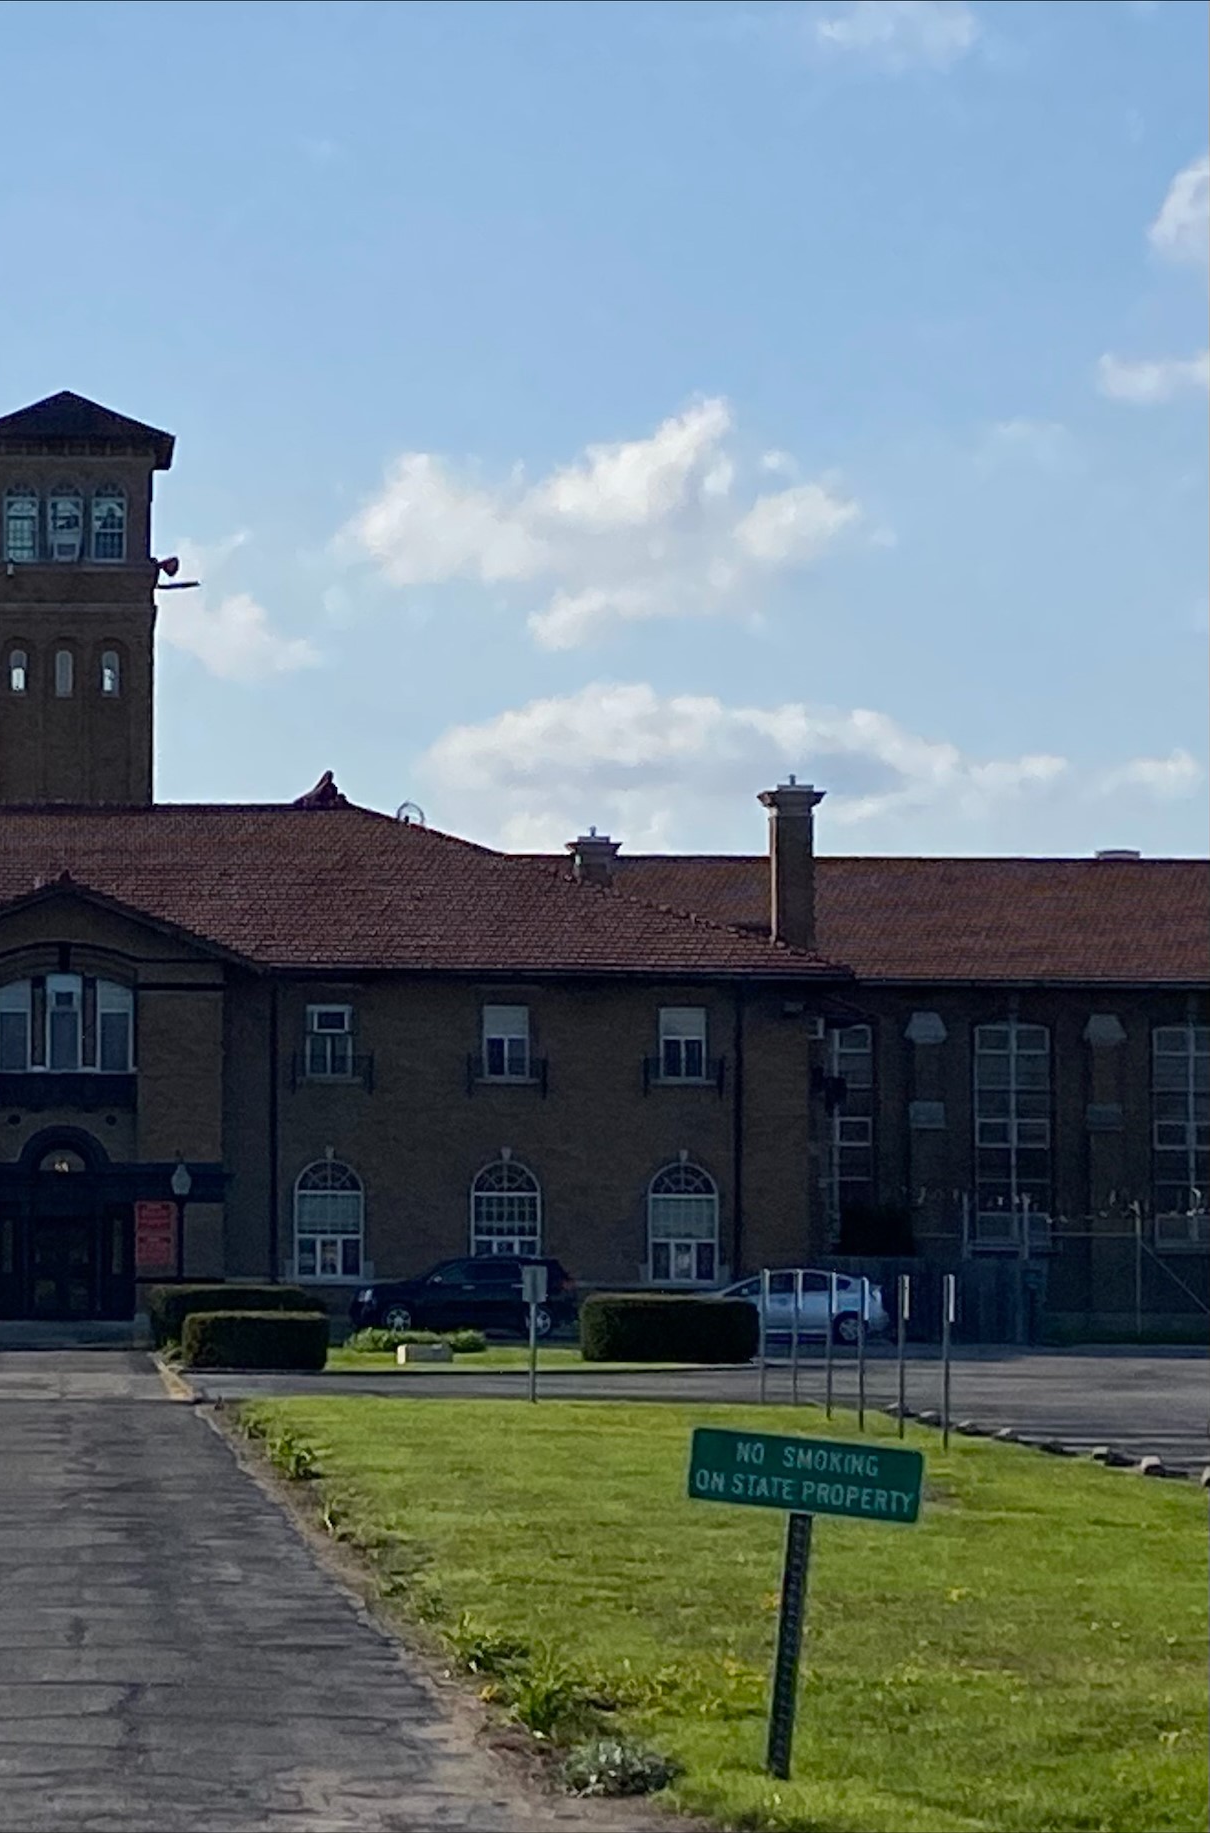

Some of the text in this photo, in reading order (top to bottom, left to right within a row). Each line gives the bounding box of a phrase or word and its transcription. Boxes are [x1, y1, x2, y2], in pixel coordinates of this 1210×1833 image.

[736, 1442, 879, 1477] NO SMOKING
[695, 1469, 915, 1514] ON STATE PROPERTY
